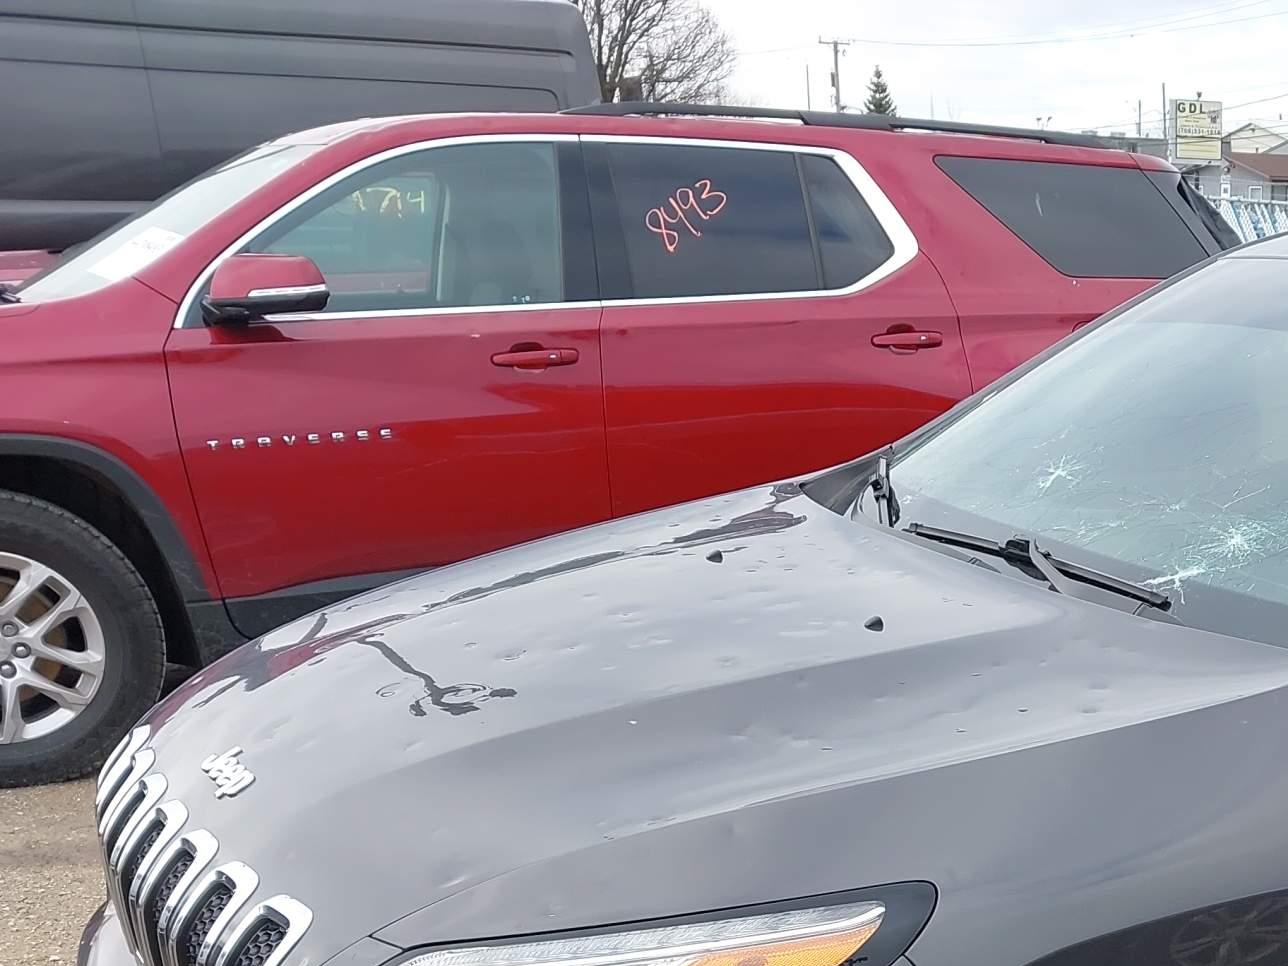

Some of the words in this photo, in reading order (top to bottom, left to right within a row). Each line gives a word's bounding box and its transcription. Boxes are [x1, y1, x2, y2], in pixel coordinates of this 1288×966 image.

[1177, 102, 1207, 114] GDL
[645, 179, 727, 253] 8493
[206, 428, 393, 450] TRAVERSE
